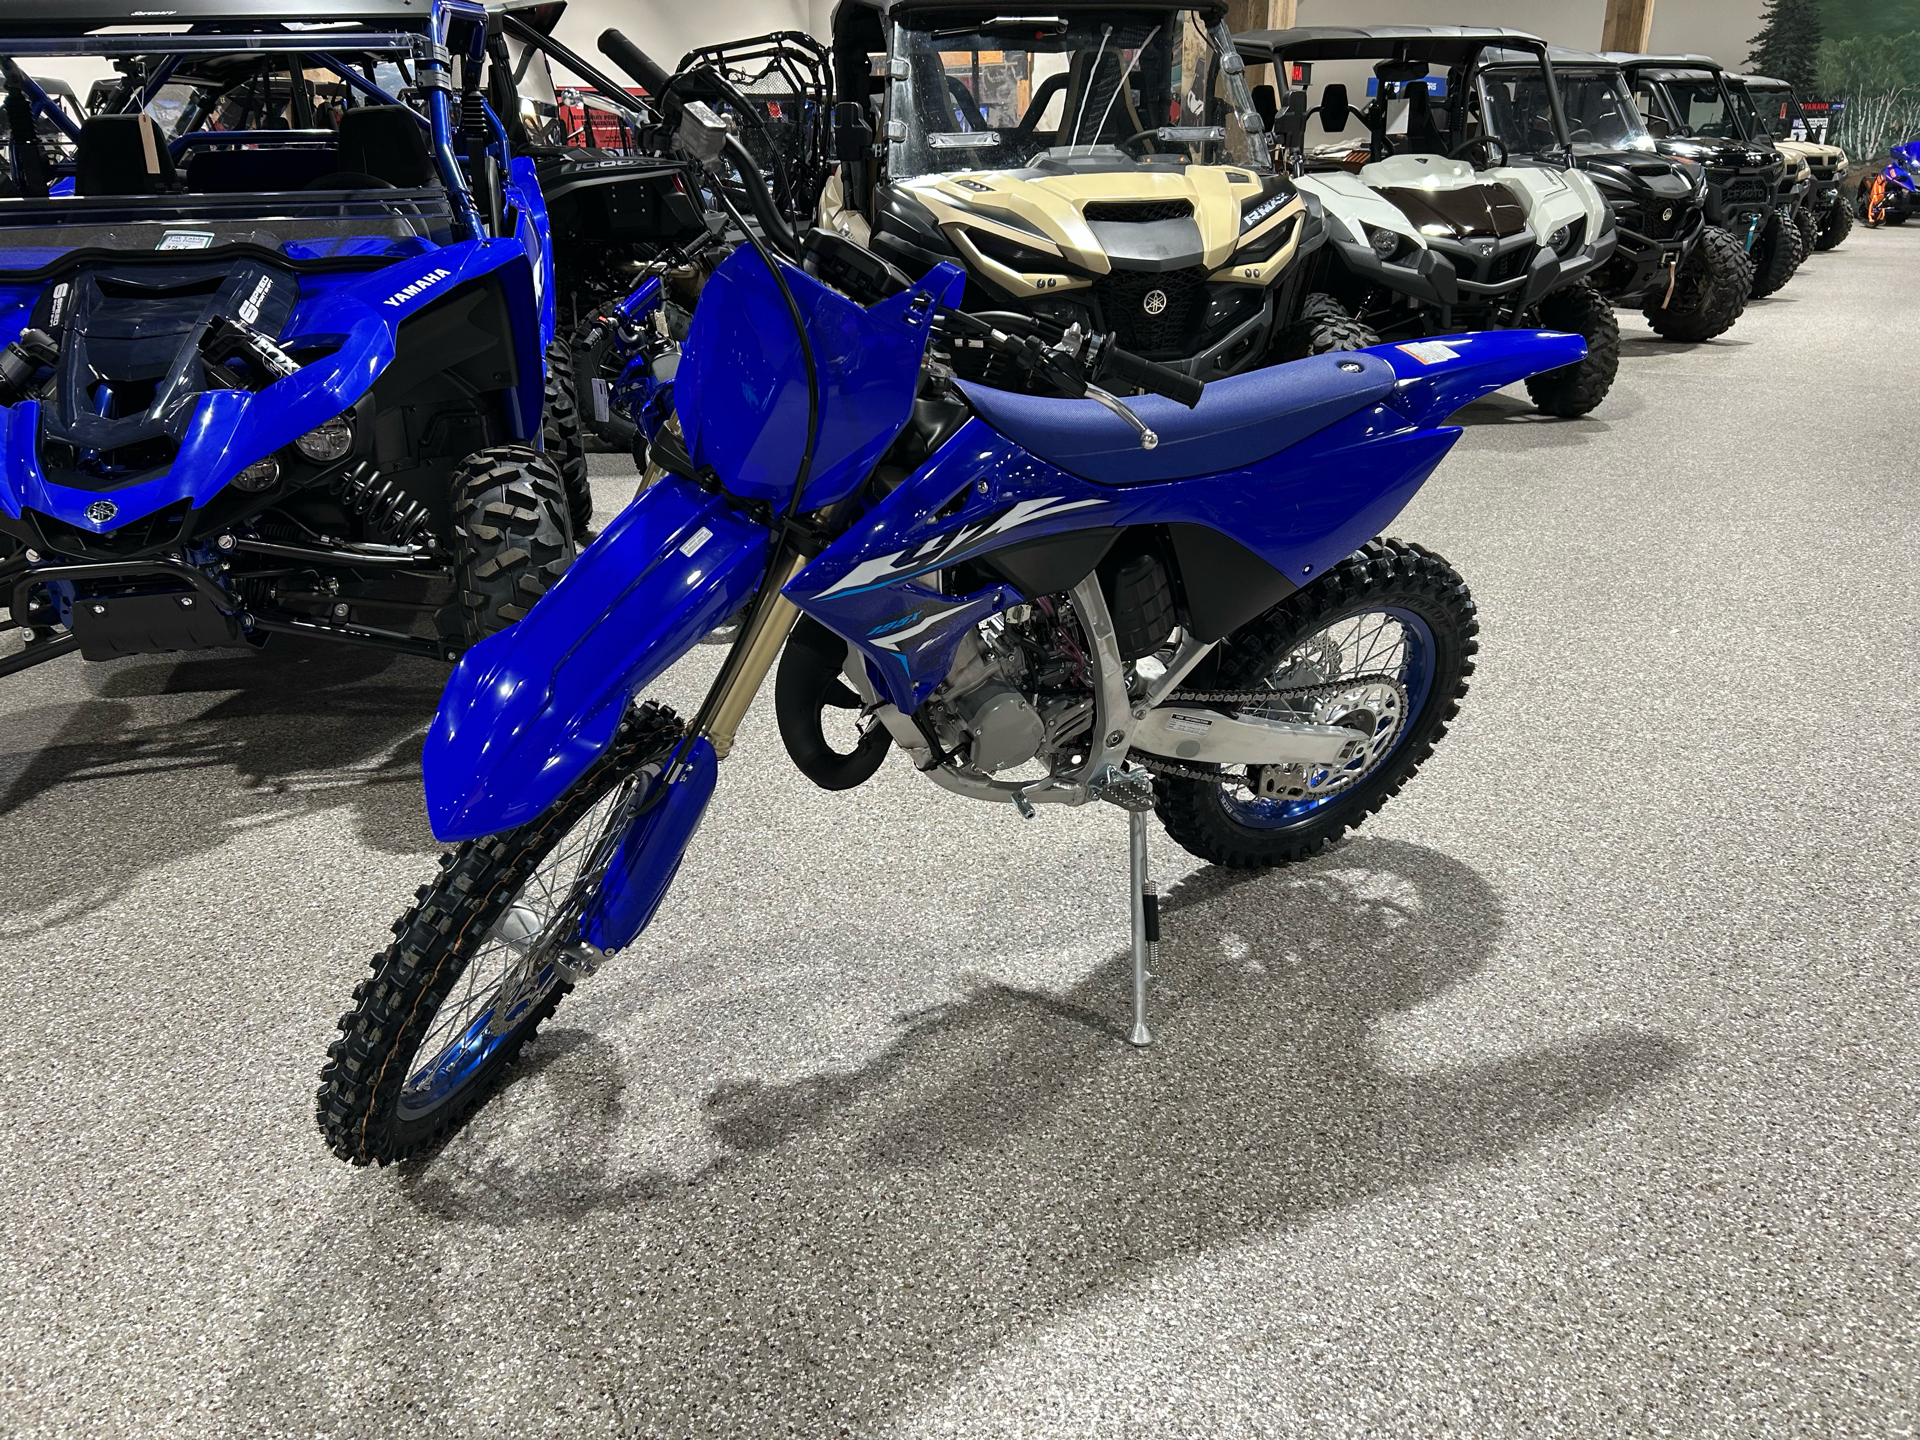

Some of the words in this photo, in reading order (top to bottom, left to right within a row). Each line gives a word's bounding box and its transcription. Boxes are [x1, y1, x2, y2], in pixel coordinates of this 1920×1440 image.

[1727, 188, 1765, 200] CFMOTO
[1243, 191, 1290, 226] RMAX
[53, 283, 68, 298] 6
[238, 299, 259, 324] 6
[249, 274, 270, 305] SPEED
[382, 268, 452, 307] YAMAHA
[53, 298, 63, 326] SPEED
[865, 609, 924, 637] 125X
